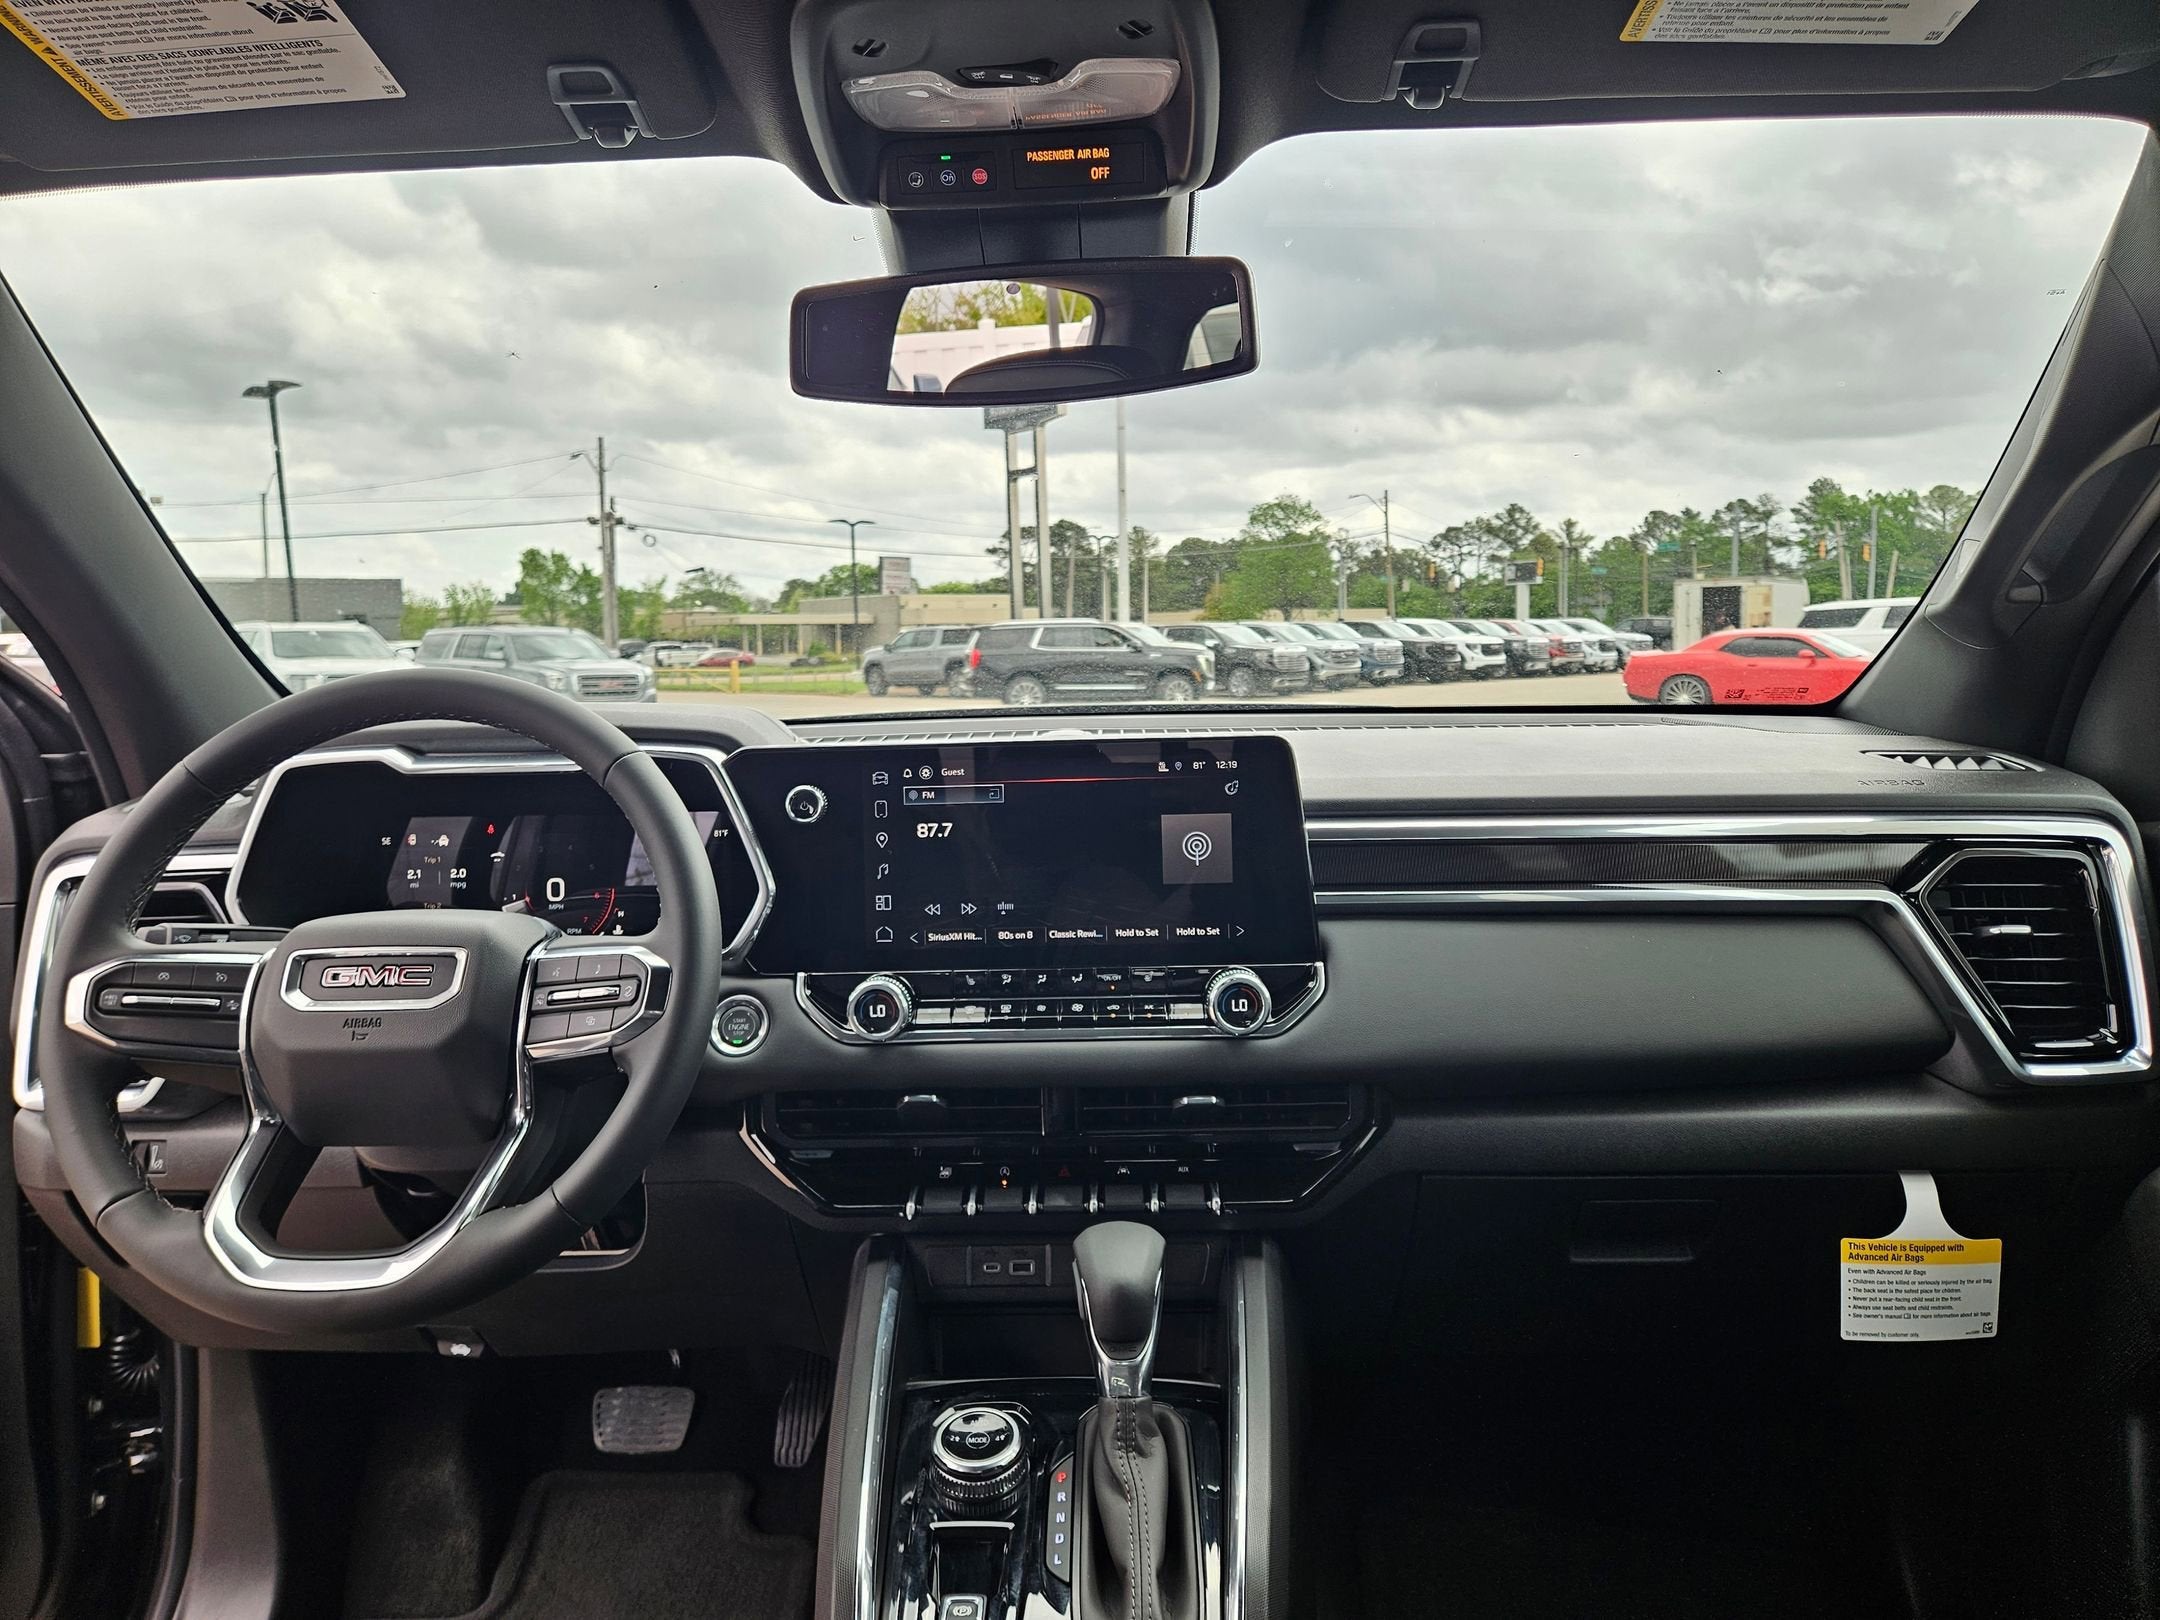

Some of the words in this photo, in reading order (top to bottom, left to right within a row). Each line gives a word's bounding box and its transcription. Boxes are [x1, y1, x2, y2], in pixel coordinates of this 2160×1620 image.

[109, 54, 137, 64] AVEC
[136, 52, 158, 61] DES
[158, 50, 187, 60] SACS
[187, 45, 253, 58] GONFLABLES
[252, 40, 324, 52] INTELLIGENTS
[49, 57, 124, 116] AVERTISSEMENT
[1026, 150, 1074, 162] PASSENGER
[1077, 149, 1092, 160] AIR
[1092, 148, 1110, 159] BAG
[1090, 166, 1110, 180] OFF
[1192, 761, 1206, 769] 81°
[1216, 760, 1238, 769] 12:19
[941, 768, 966, 776] Guest
[714, 829, 728, 838] 81°F
[916, 822, 953, 838] 87.7
[382, 836, 392, 846] SE
[406, 868, 422, 880] 2.1
[450, 868, 467, 879] 2.0
[546, 877, 566, 902] 0
[928, 932, 963, 942] SiriusXM
[998, 932, 1014, 940] 80s
[1049, 930, 1076, 939] Classic
[1116, 928, 1134, 937] Hold
[1146, 928, 1159, 937] Set
[1176, 928, 1195, 936] Hold
[1206, 927, 1220, 936] Set
[321, 964, 434, 988] GMC
[869, 1004, 886, 1018] LO
[1232, 999, 1248, 1012] LO
[342, 1016, 382, 1028] AIRBAG
[1848, 1242, 1866, 1250] This
[1868, 1243, 1898, 1252] Vehicle
[1900, 1244, 1907, 1252] is
[1909, 1244, 1946, 1253] Equipped
[1848, 1252, 1888, 1261] Advanced
[1904, 1254, 1924, 1263] Bags
[1056, 1472, 1067, 1483] P
[1057, 1492, 1066, 1502] R
[1056, 1512, 1065, 1523] N
[1055, 1533, 1064, 1544] D
[1054, 1554, 1062, 1564] L
